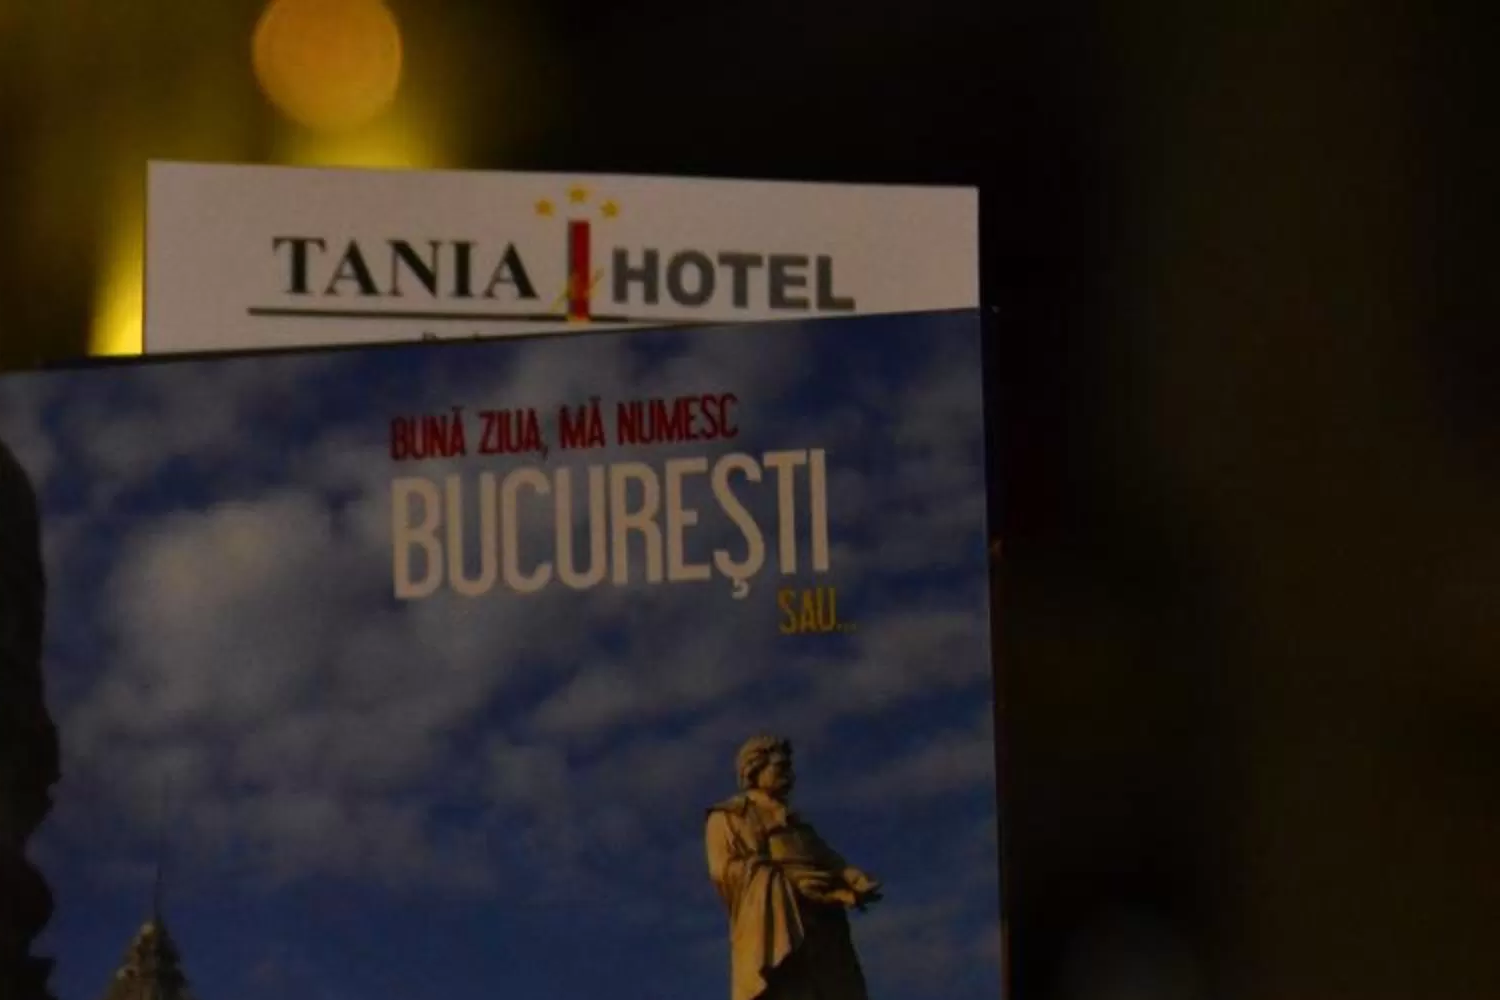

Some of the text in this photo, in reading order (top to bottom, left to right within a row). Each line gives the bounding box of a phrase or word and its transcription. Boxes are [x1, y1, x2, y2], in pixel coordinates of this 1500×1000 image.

[273, 237, 855, 311] TANIA HOTEL
[390, 393, 739, 461] BUNĂ ZIUA, MĂ NUMESC
[392, 447, 830, 600] BUCUREŞTI
